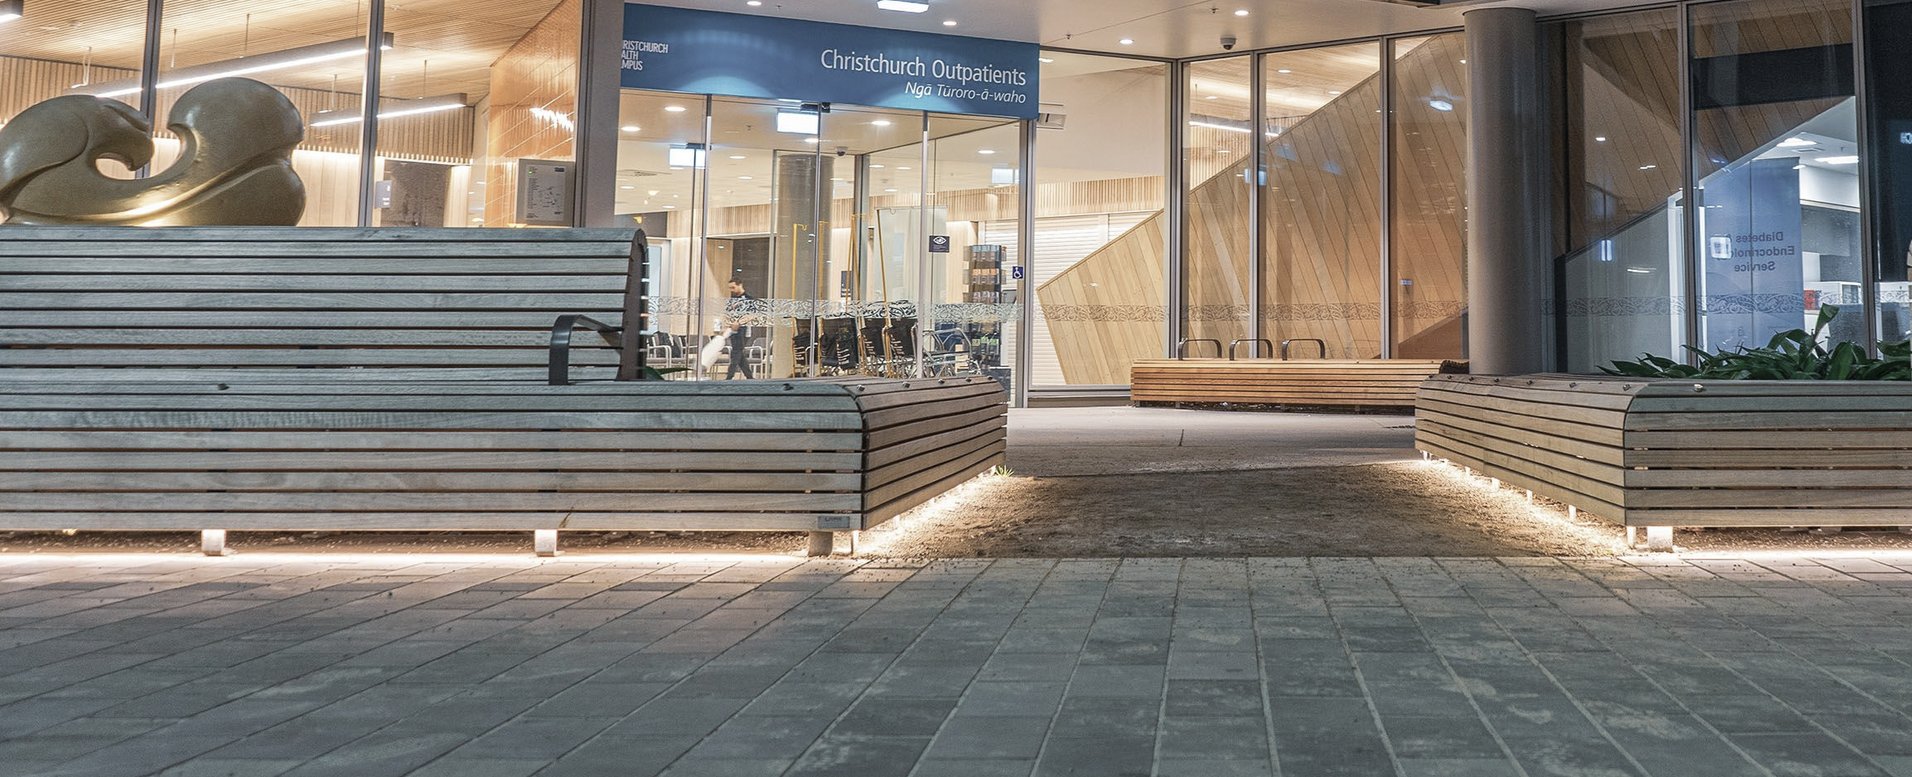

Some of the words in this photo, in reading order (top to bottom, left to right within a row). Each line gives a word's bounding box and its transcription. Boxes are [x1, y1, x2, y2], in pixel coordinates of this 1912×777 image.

[622, 40, 669, 53] RISTCHURCH
[621, 50, 639, 60] ALTH
[621, 59, 643, 71] MPUS
[821, 49, 926, 77] Christchurch
[931, 59, 1027, 85] Outpatients
[904, 81, 932, 98] Ngā
